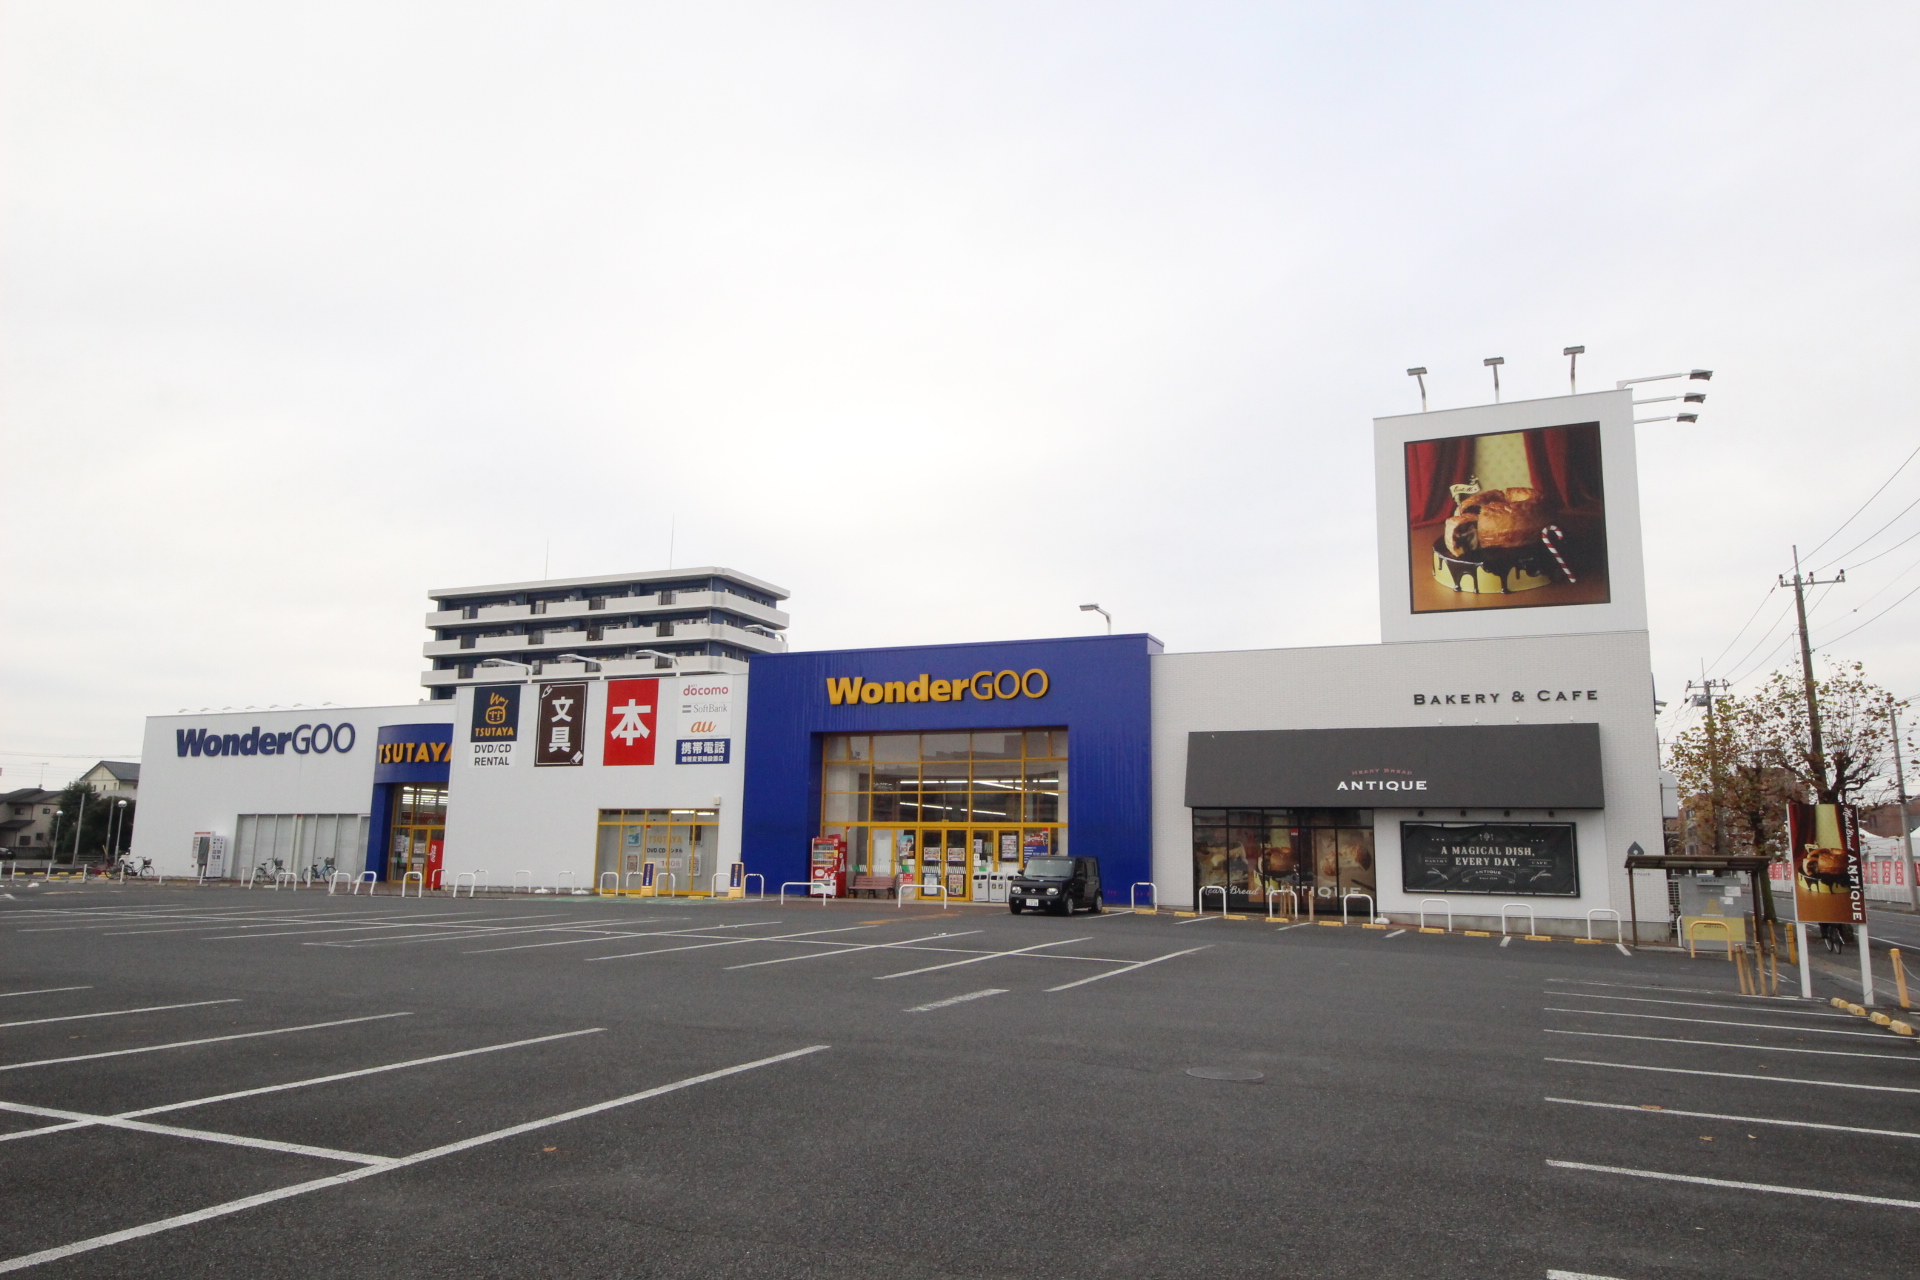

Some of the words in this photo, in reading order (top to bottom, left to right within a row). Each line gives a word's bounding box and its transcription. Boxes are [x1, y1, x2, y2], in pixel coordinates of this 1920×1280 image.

[683, 685, 728, 696] docomo
[826, 668, 1049, 705] WonderGOO
[1413, 693, 1500, 705] BAKERY
[1511, 691, 1525, 702] &
[1537, 690, 1598, 701] CAFE
[693, 704, 728, 713] SoftBank
[549, 696, 574, 753] 文具
[610, 698, 652, 746] 本
[690, 721, 717, 733] au
[475, 727, 514, 737] TSUTAYA
[176, 722, 356, 757] WonderGOO
[474, 744, 512, 754] DVD/CD
[681, 741, 725, 754] 携帯電話
[474, 757, 510, 766] RENTAL
[1336, 780, 1427, 792] ANTIQUE
[649, 835, 683, 844] TSUTYA
[1441, 846, 1448, 855] A
[1452, 846, 1502, 855] MAGICAL
[1505, 847, 1535, 857] DISH,
[1455, 857, 1490, 866] EVERY
[1494, 857, 1520, 867] DAY.
[1848, 854, 1862, 921] ANTIQUE
